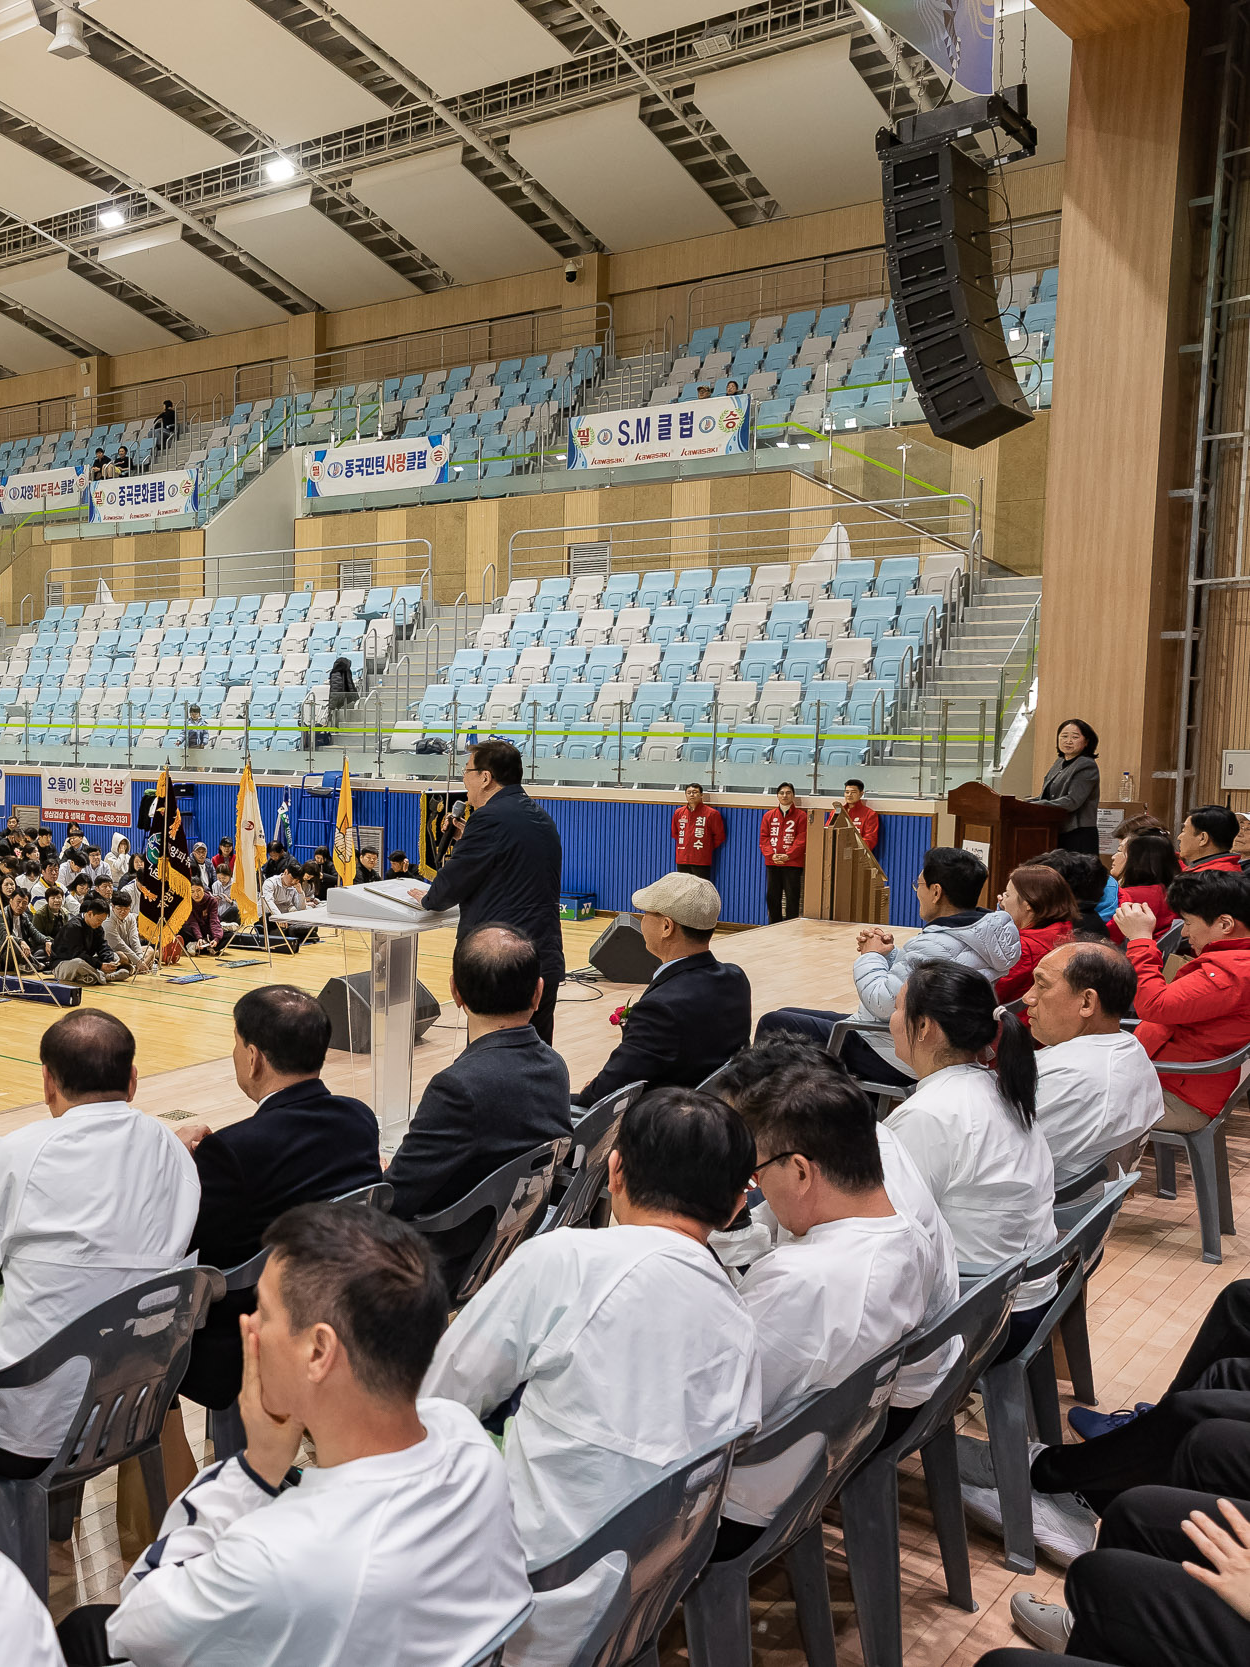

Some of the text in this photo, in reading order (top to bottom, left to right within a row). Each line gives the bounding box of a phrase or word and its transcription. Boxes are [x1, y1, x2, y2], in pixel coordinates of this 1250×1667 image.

[617, 410, 694, 447] S.M 클럽
[723, 411, 740, 429] 승
[576, 428, 590, 446] 필
[345, 449, 428, 478] 동국민턴사랑클럽
[118, 480, 165, 507] 중곡문화클럽
[47, 776, 124, 795] 오돌이 생 삼겹살
[693, 816, 706, 850] 최동수
[785, 820, 795, 833] 2
